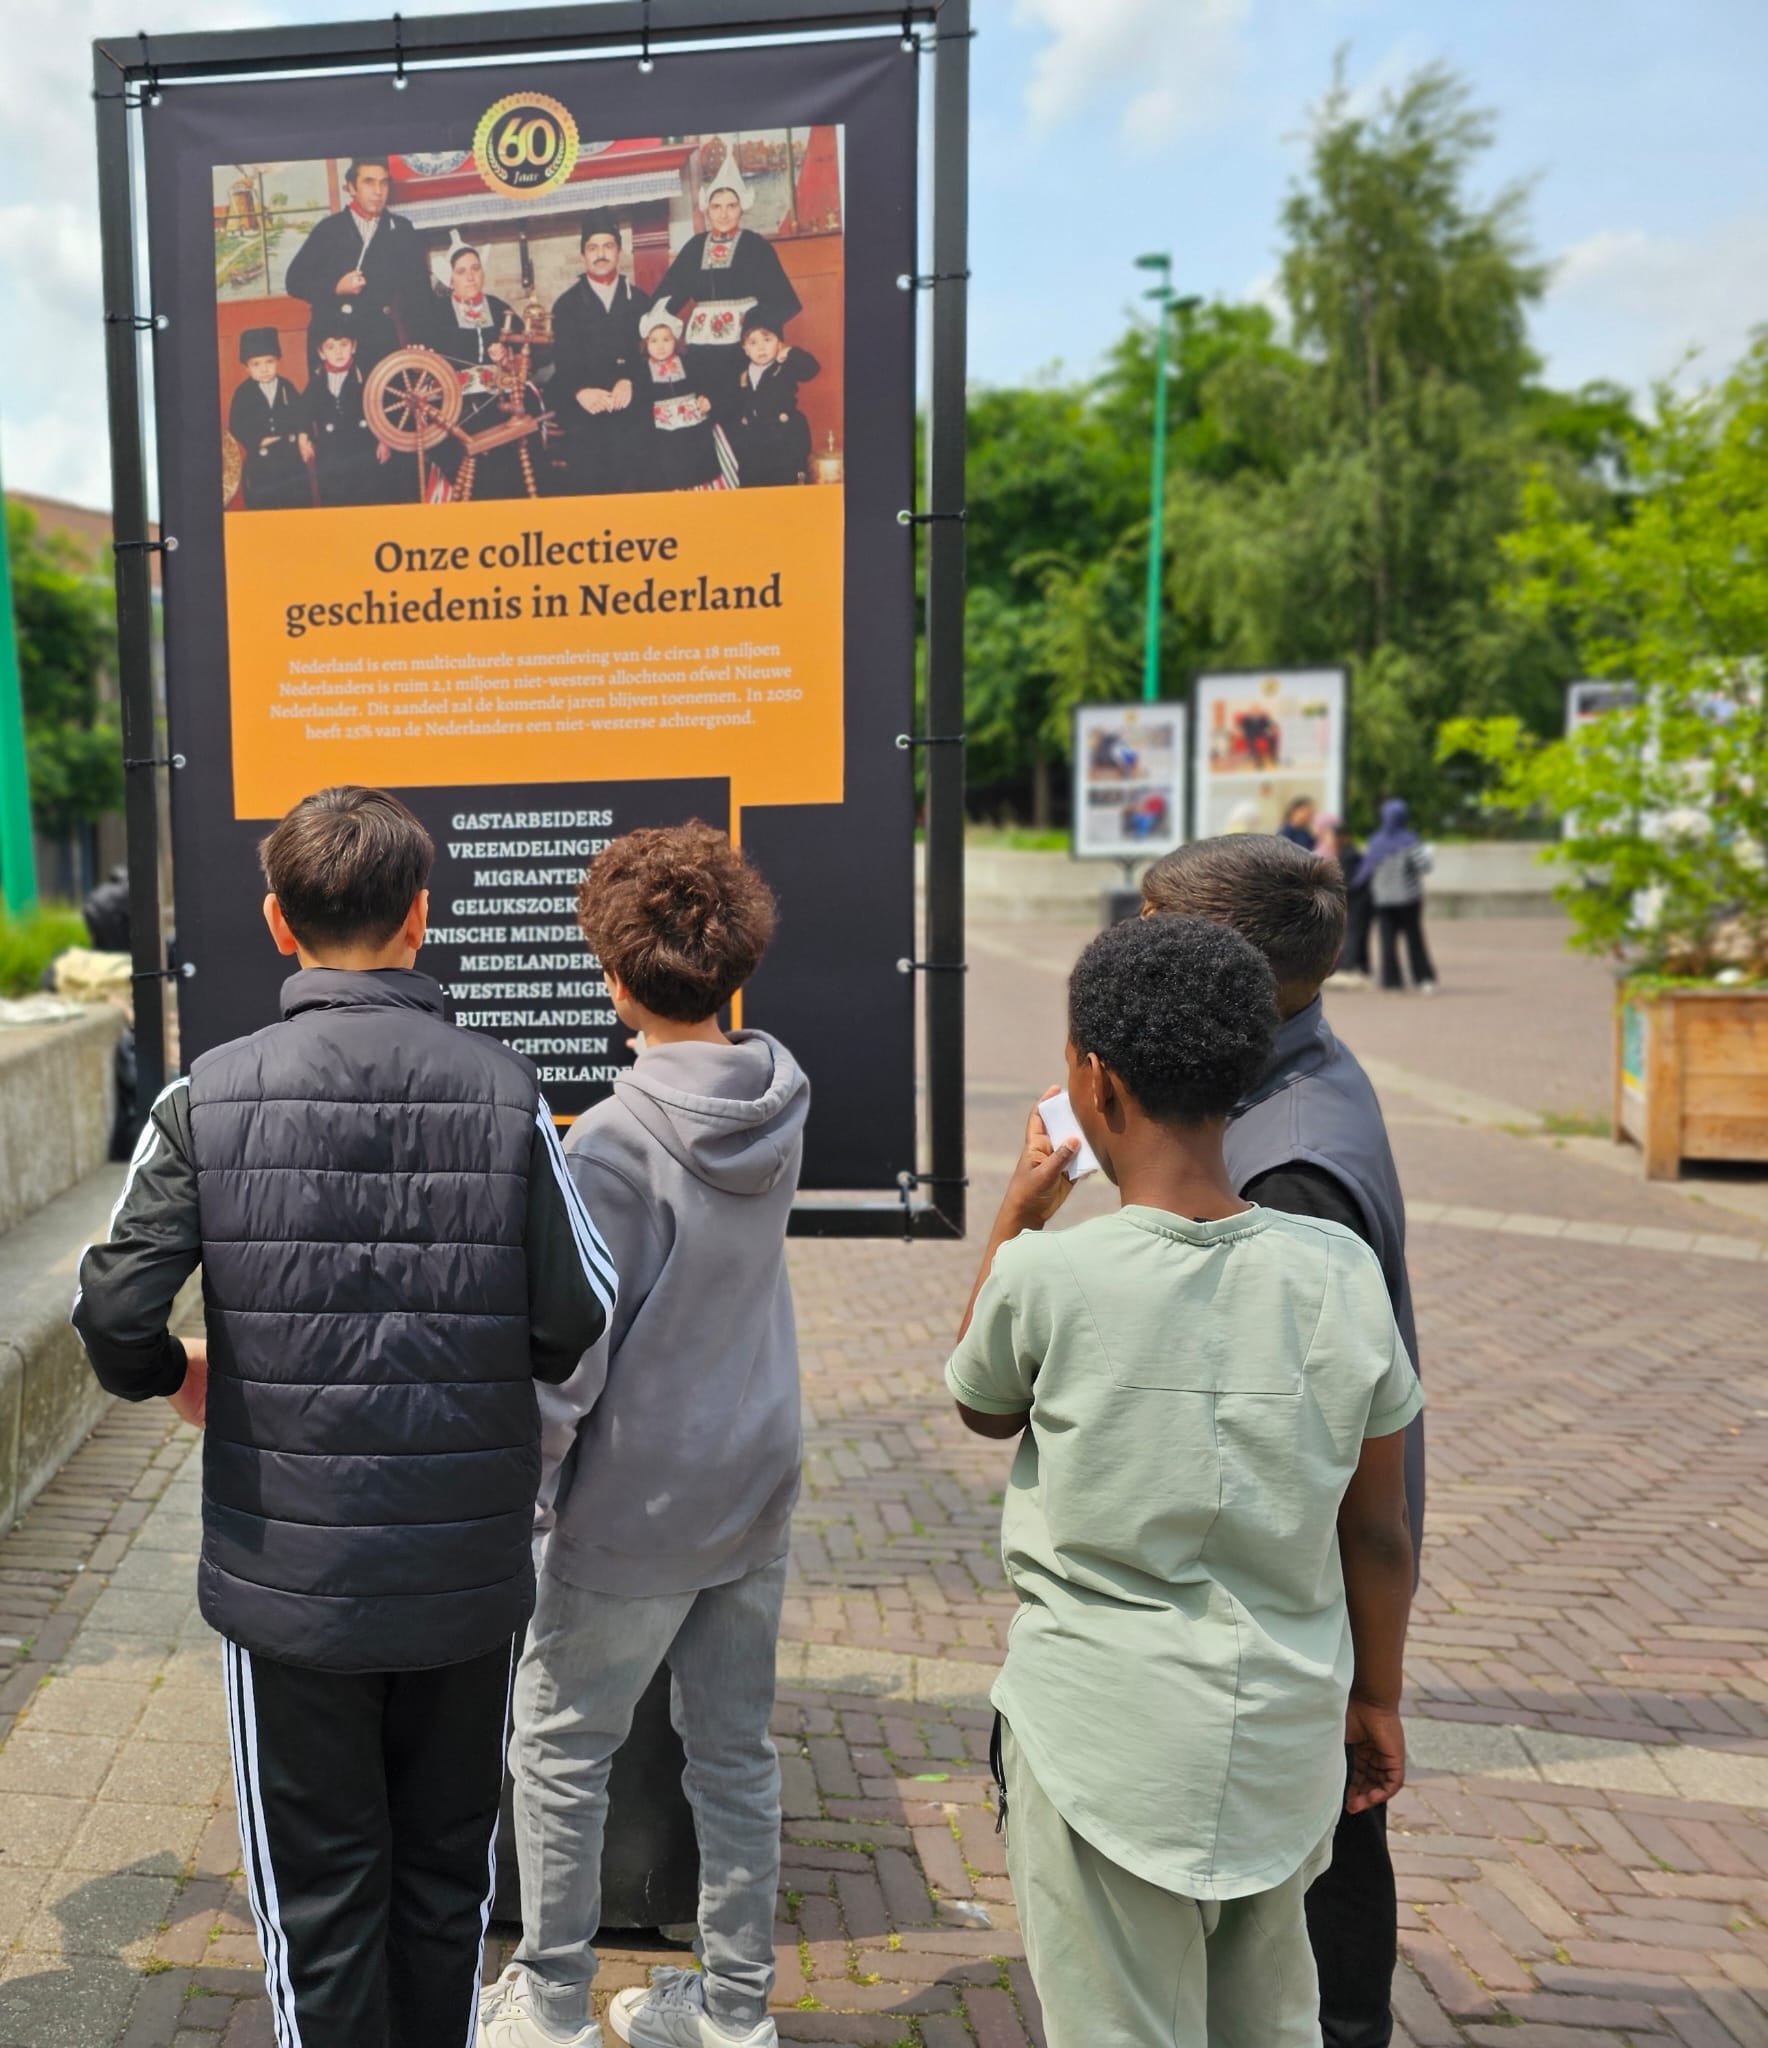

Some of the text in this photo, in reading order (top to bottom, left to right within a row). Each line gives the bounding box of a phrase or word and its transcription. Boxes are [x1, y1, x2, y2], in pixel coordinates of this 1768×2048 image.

[498, 117, 556, 167] 60
[374, 529, 678, 573] Onze collectieve
[286, 572, 783, 638] geschiedenis in Nederland
[289, 641, 781, 674] Nederland is een multiculturele samenleving van de circa 18 miljoen
[278, 664, 792, 698] Nederlanders is ruim 2,1 miljoen niet-westers allochtoon ofwel Nieuwe
[269, 687, 803, 720] Nederlander. Dit aandeel zal de komende jaren blijven toenemen. In 2050
[305, 722, 341, 740] heeft
[375, 724, 401, 737] van
[405, 721, 421, 737] de
[425, 718, 522, 737] Nederlanders
[526, 718, 552, 732] een
[555, 714, 655, 732] niet-westerse
[659, 709, 756, 730] achtergrond.
[452, 810, 613, 830] GASTARBEIDERS
[452, 897, 580, 916] GELUKSZOEK
[424, 926, 506, 945] TNISCHE
[439, 981, 611, 1000] -WESTERSE MIGR
[455, 1009, 617, 1028] BUITENLANDERS
